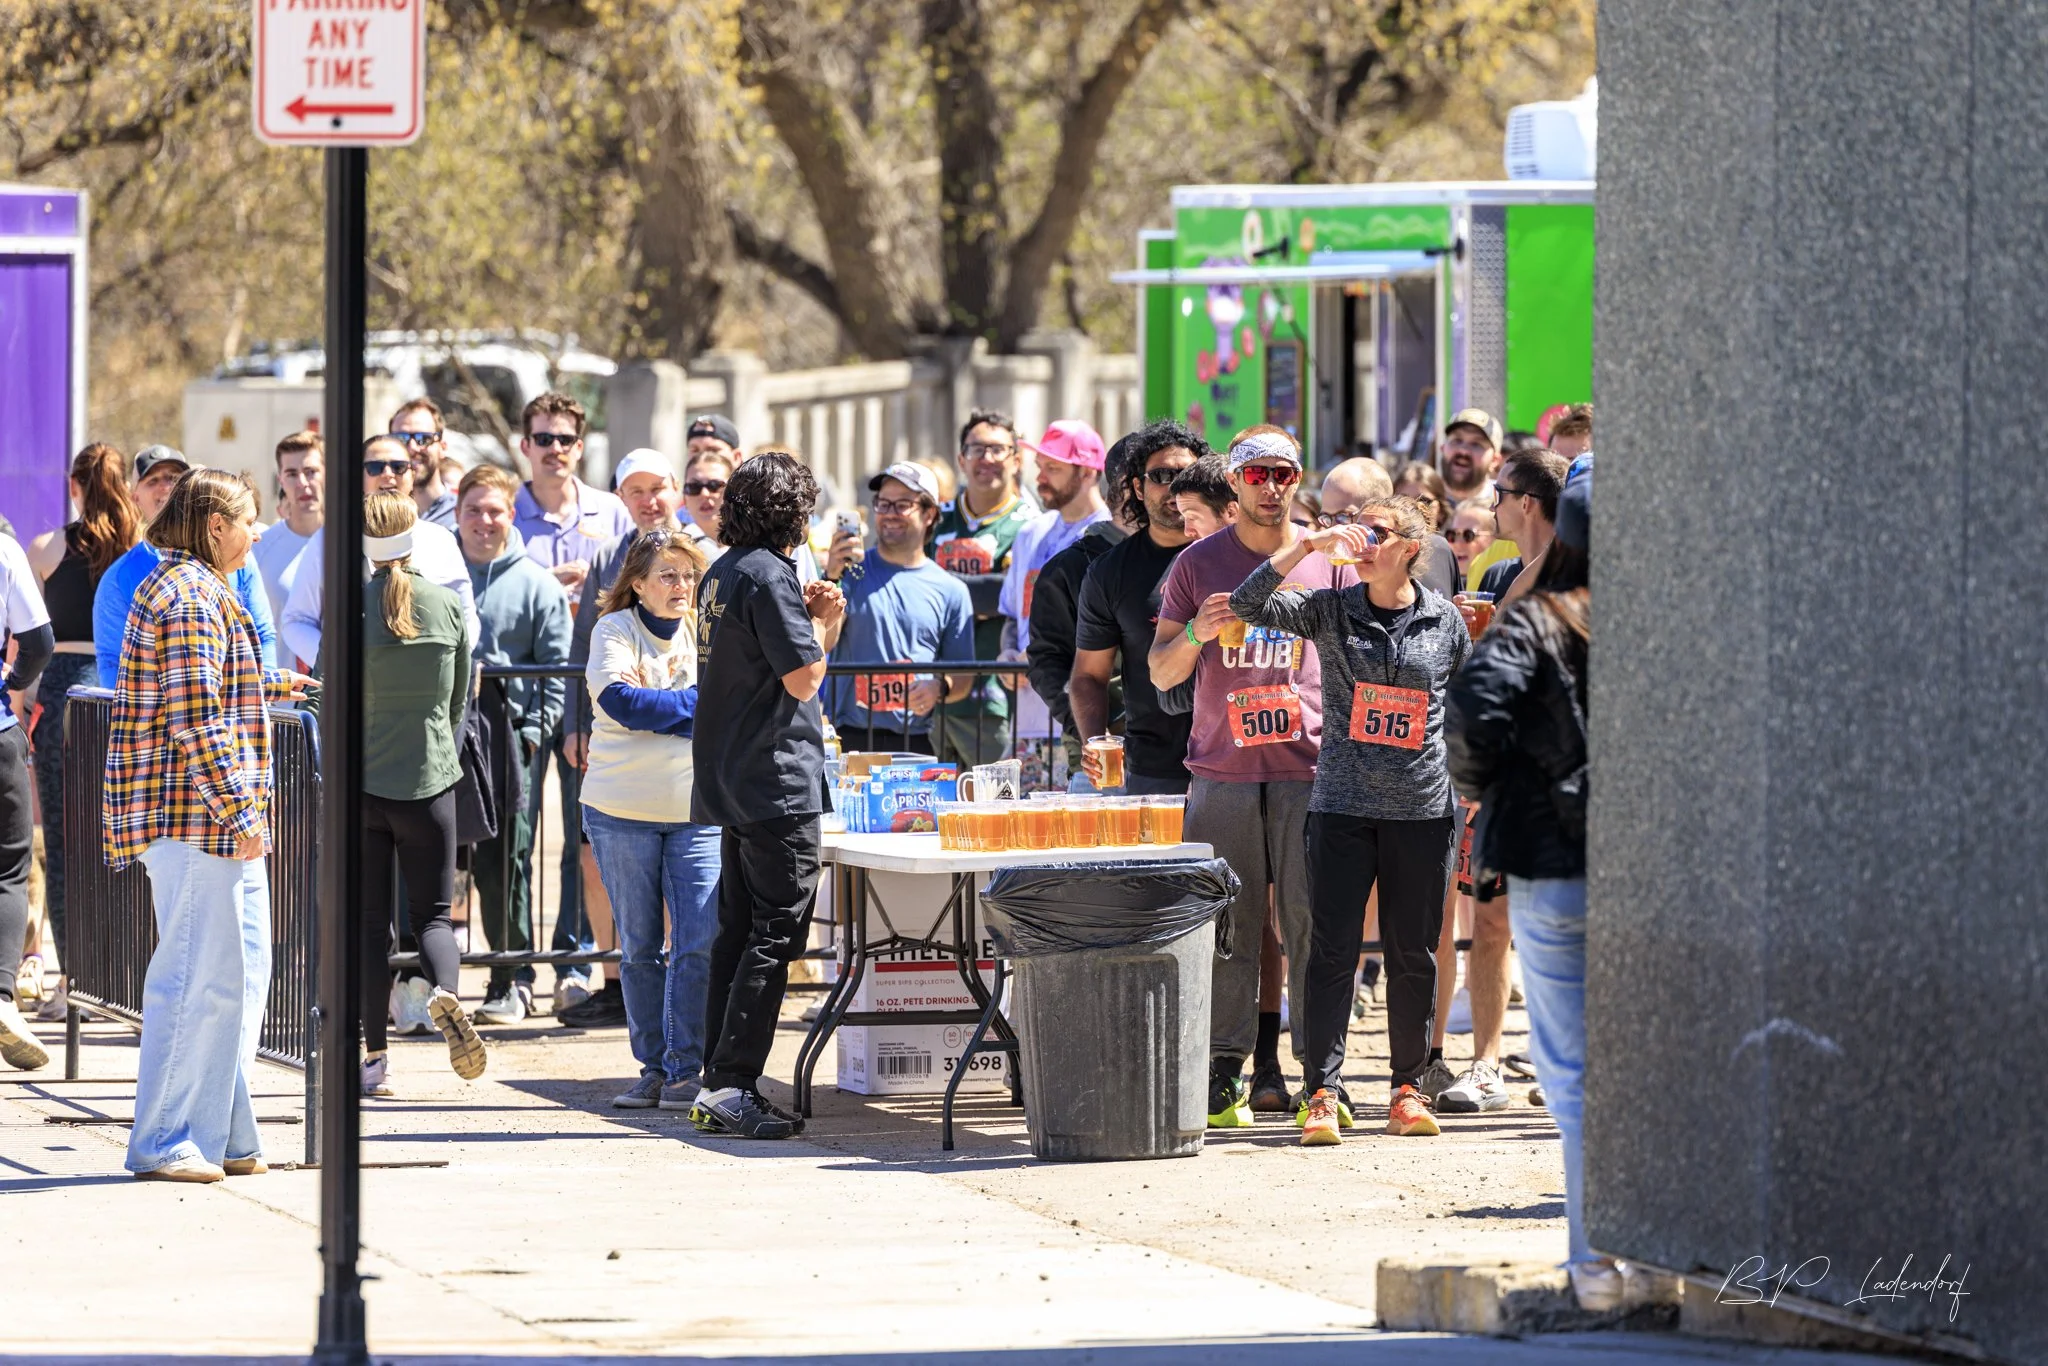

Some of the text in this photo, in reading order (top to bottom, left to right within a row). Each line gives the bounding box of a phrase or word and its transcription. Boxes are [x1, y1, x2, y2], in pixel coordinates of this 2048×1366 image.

[308, 19, 369, 50] ANY
[304, 57, 374, 89] TIME
[1222, 638, 1292, 669] CLUB
[870, 681, 904, 704] 519
[1241, 708, 1289, 738] 500
[1364, 708, 1411, 739] 515
[914, 978, 956, 987] COLLECTION
[876, 999, 885, 1007] 16
[886, 998, 902, 1006] OZ.
[903, 997, 924, 1006] PETE
[926, 996, 969, 1005] DRINKING
[944, 1056, 1002, 1071] 31698
